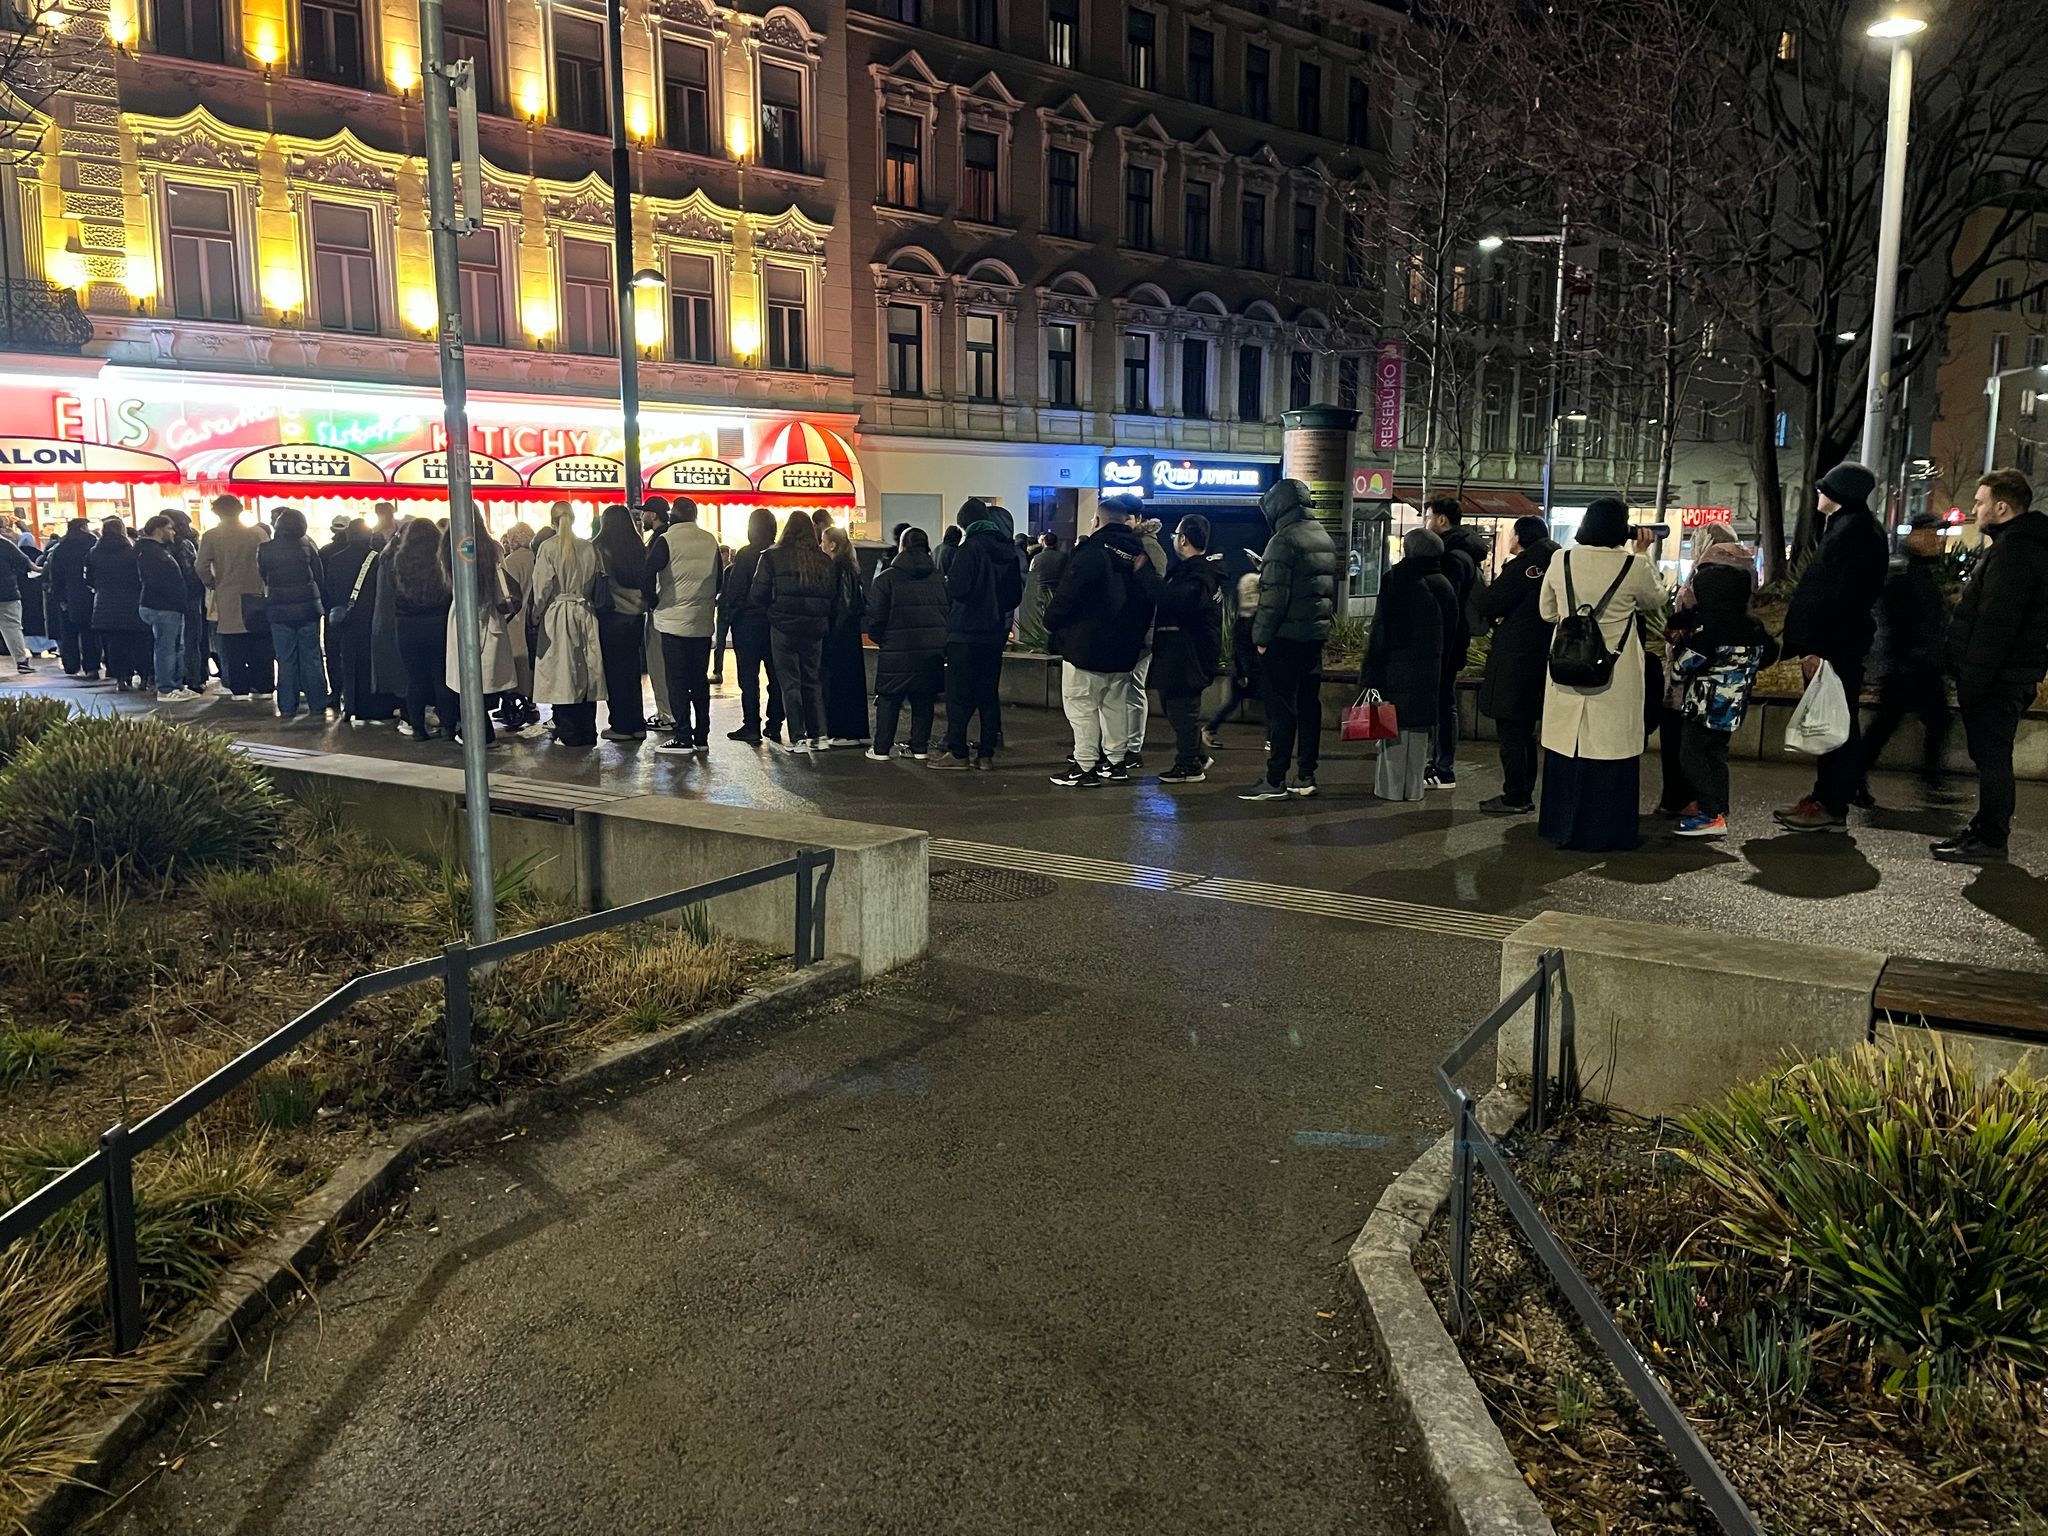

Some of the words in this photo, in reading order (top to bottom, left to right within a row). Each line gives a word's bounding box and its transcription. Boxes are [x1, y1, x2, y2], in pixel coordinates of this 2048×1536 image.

[1380, 364, 1397, 448] REISEBÜRO
[53, 396, 150, 447] EIS
[474, 424, 588, 457] TICHY
[270, 460, 349, 476] TICHY
[556, 469, 617, 482] TICHY
[675, 472, 729, 485] TICHY
[783, 476, 833, 488] TICHY
[1682, 508, 1730, 526] APOTHEKE
